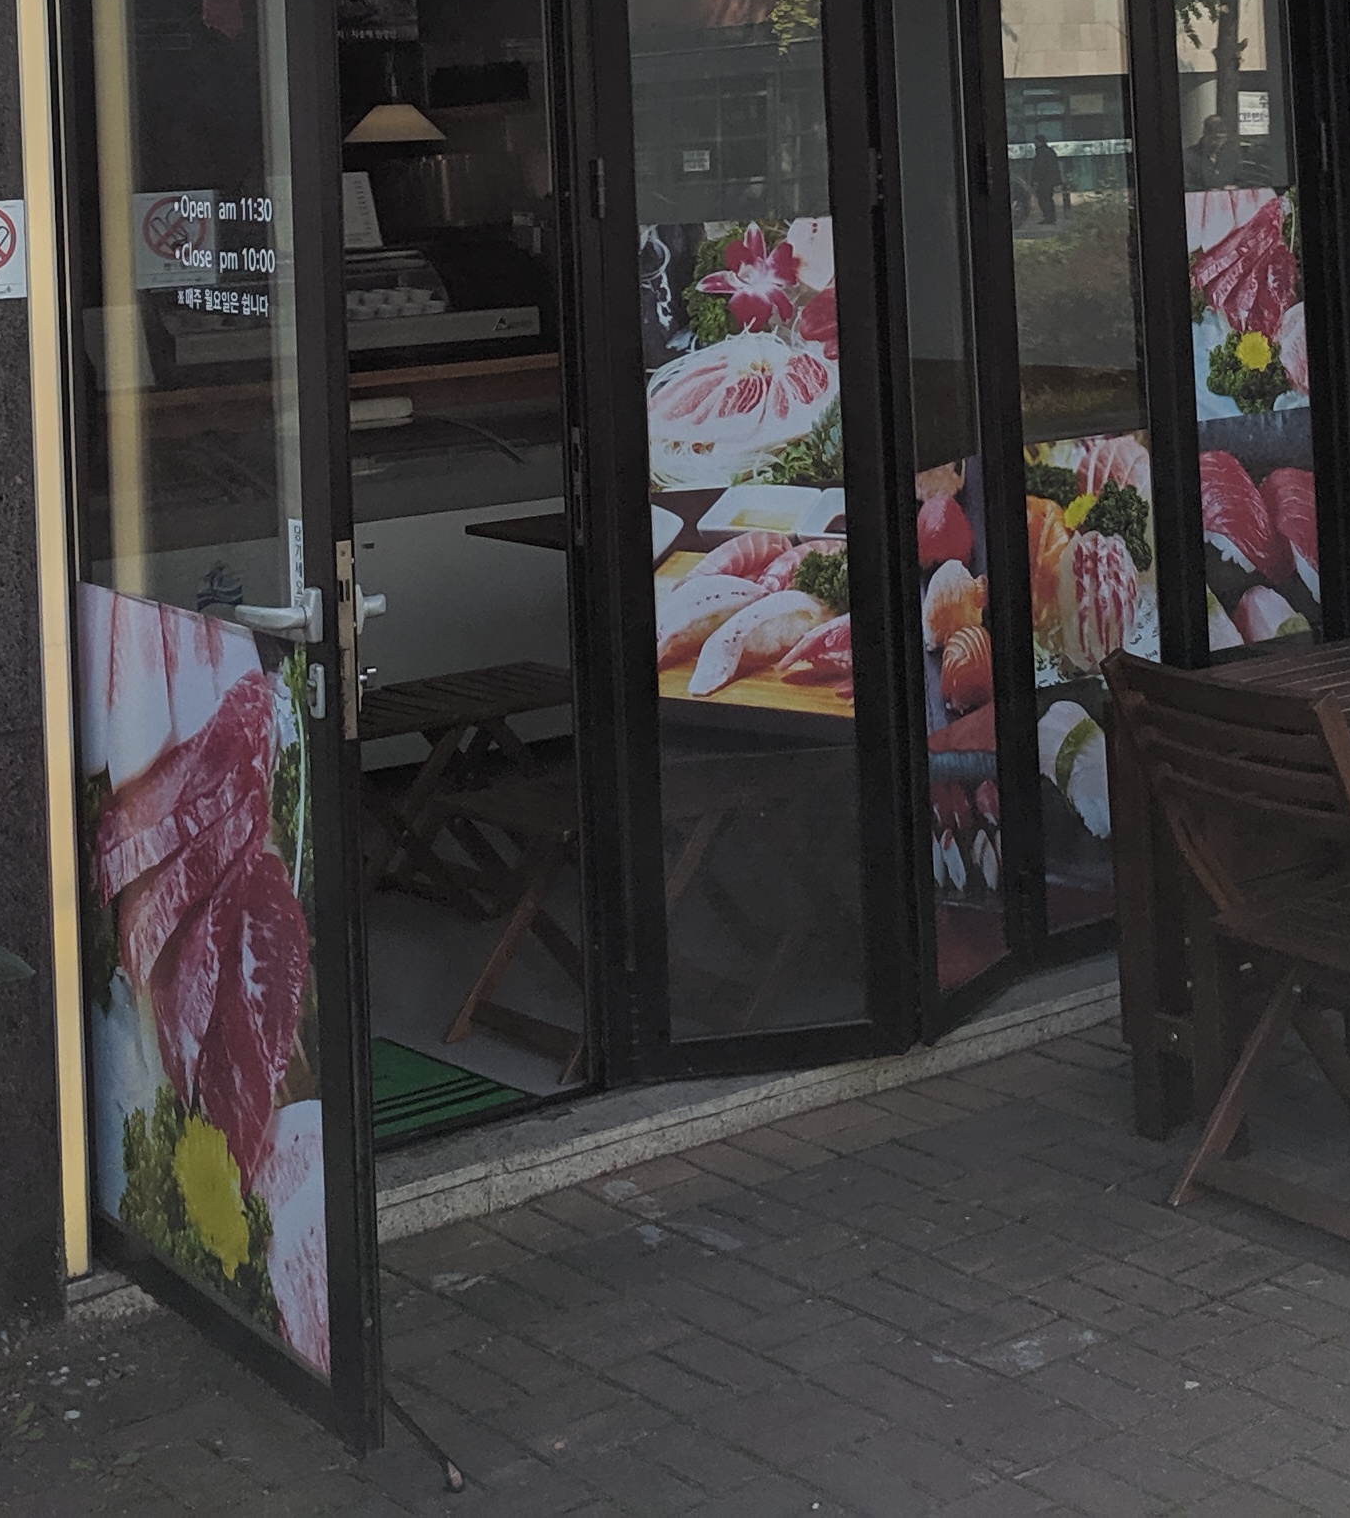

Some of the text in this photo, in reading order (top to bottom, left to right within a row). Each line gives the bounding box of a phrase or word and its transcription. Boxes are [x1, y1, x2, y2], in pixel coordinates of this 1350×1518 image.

[180, 194, 273, 222] Open am 11:30
[181, 242, 276, 273] Close pm 10:00
[204, 288, 240, 314] 월요일은
[241, 292, 270, 318] 쉽니다
